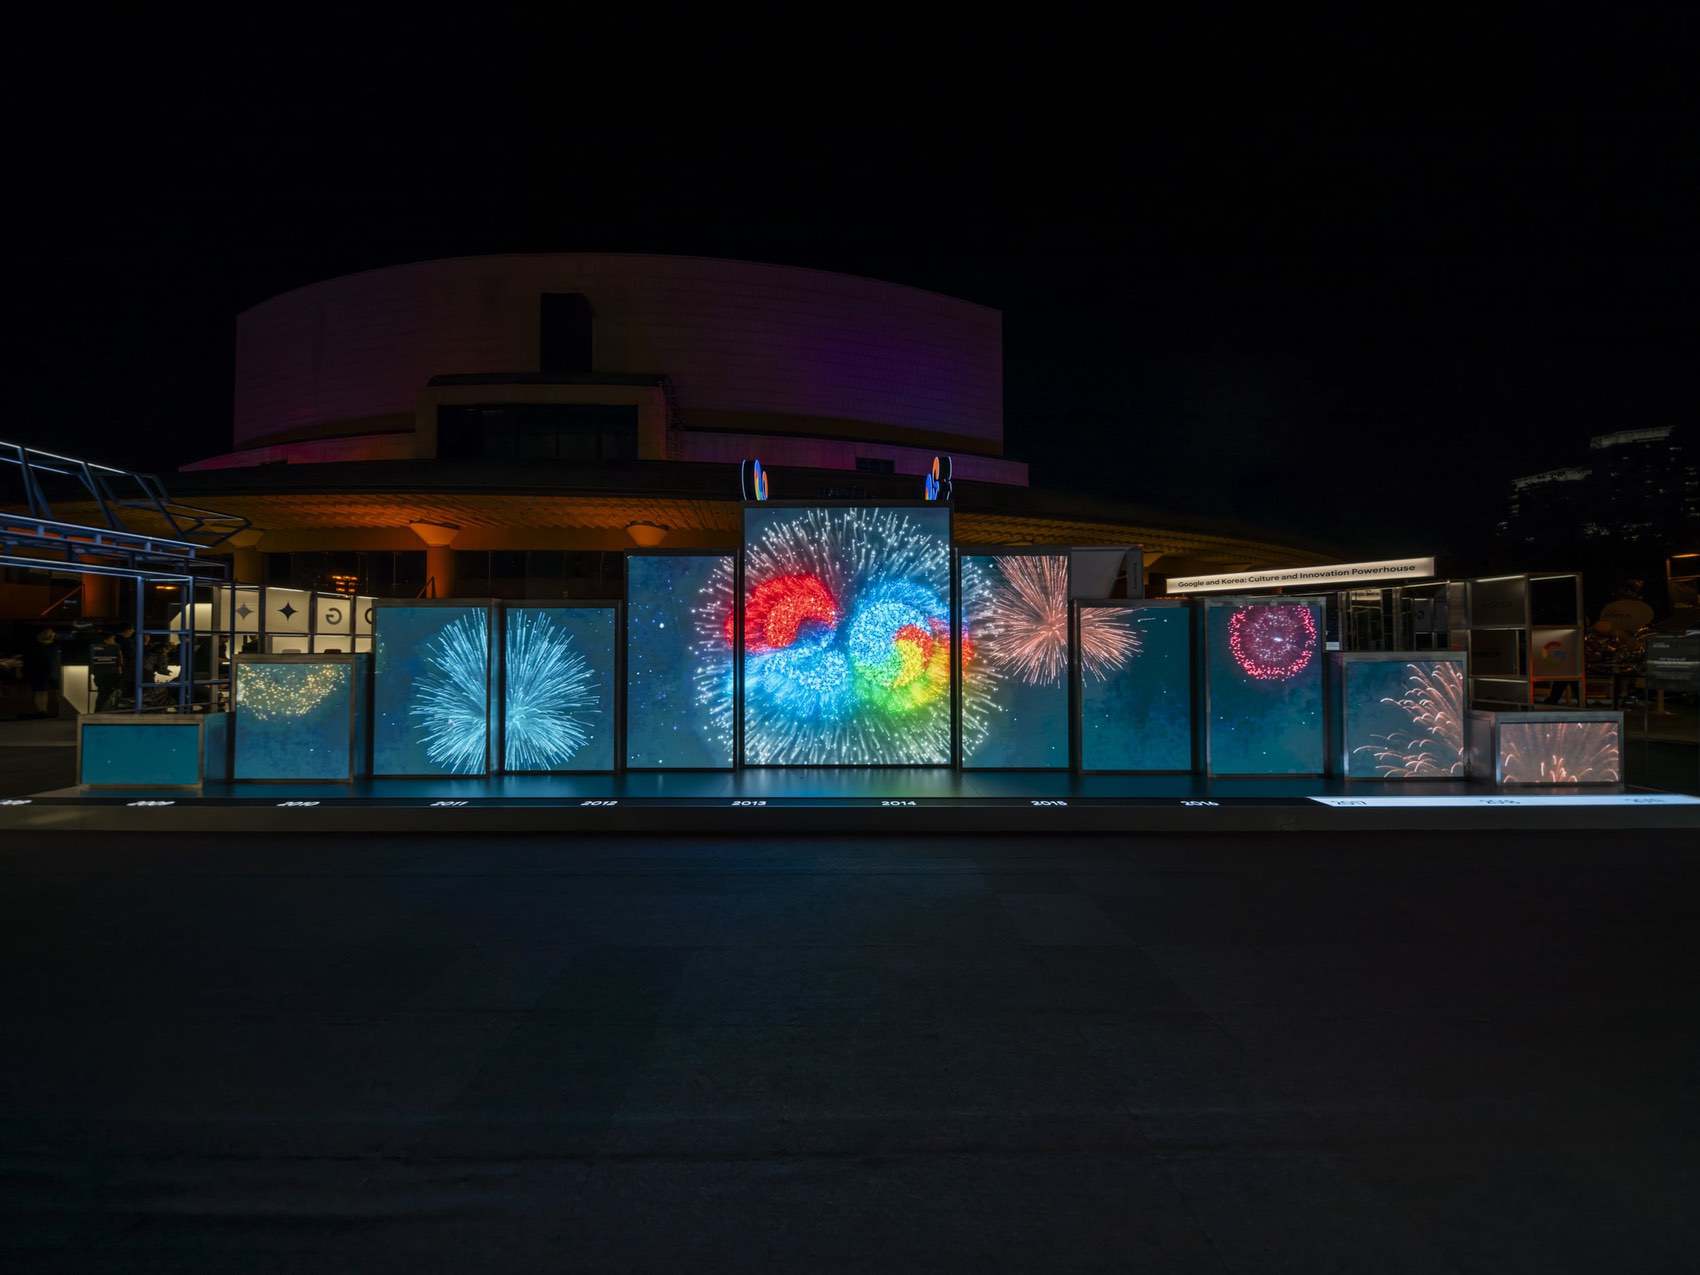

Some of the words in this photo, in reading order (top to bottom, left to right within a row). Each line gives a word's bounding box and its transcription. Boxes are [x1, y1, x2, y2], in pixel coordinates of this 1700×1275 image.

[1178, 580, 1204, 588] Google
[1221, 577, 1247, 585] Korea:
[1248, 575, 1280, 583] Culture
[1299, 570, 1350, 579] Innovation
[1351, 565, 1416, 575] Powerhouse
